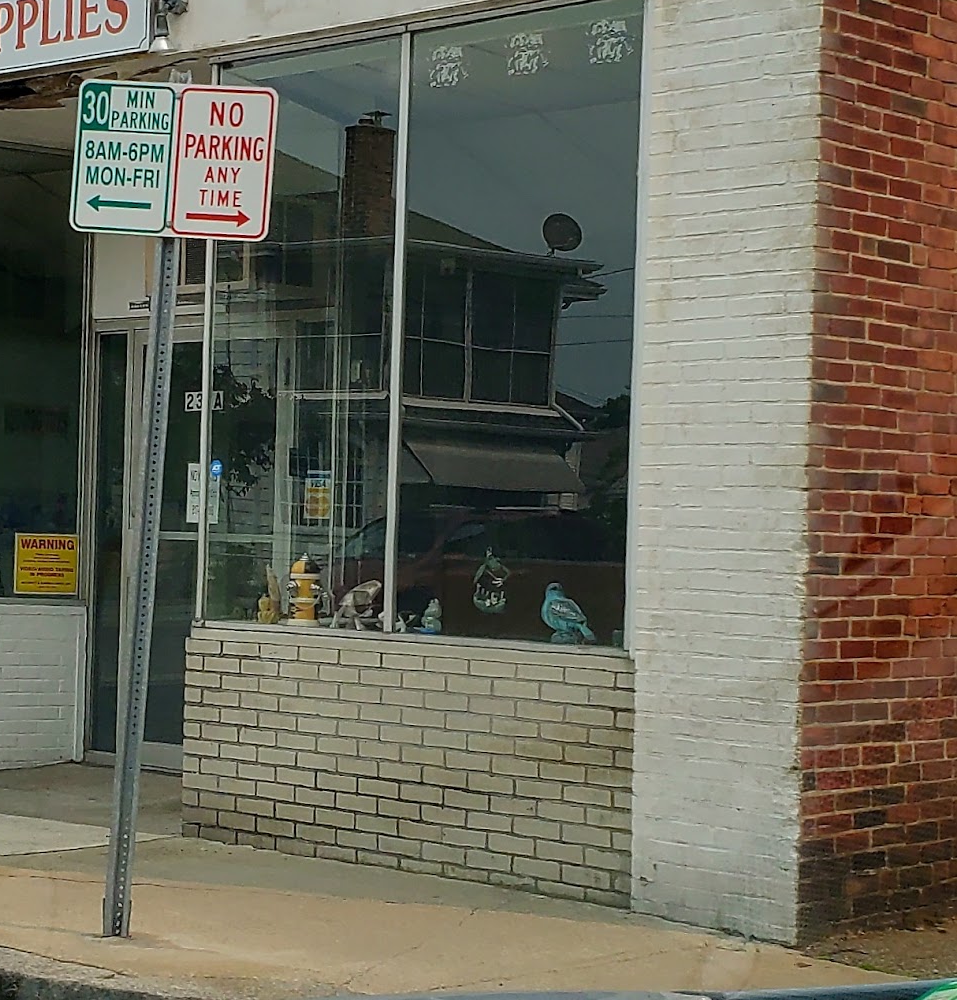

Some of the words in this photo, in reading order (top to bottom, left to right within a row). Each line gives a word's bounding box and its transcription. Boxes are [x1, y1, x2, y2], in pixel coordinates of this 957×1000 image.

[82, 90, 110, 125] 30
[126, 90, 156, 109] MIN
[209, 101, 245, 128] NO
[110, 111, 170, 131] PARKING
[85, 140, 164, 163] 8AM-6PM
[184, 133, 265, 162] PARKING
[85, 166, 161, 189] MON-FRI
[204, 166, 242, 184] ANY
[199, 189, 243, 208] TIME
[20, 538, 75, 551] WARNING
